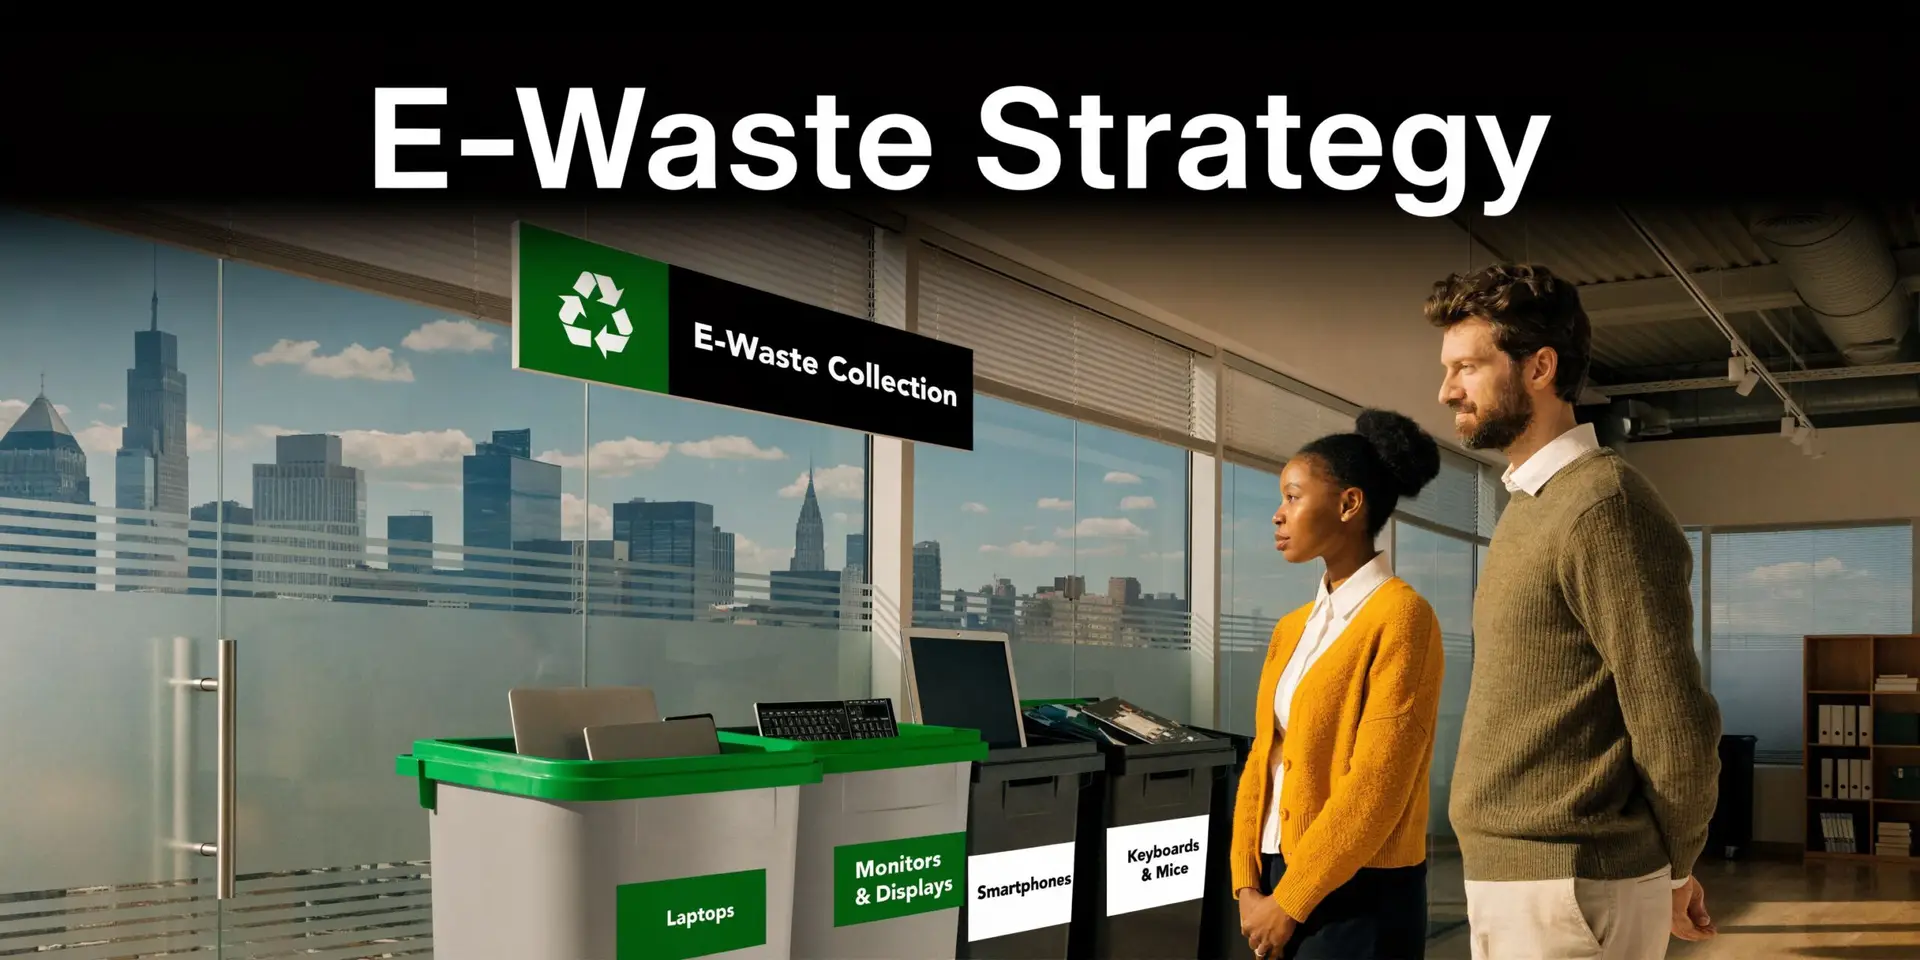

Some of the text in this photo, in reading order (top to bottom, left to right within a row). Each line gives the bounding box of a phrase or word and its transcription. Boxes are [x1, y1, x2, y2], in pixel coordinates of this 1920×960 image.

[694, 321, 957, 407] E-Waste Collection
[1127, 838, 1200, 864] Keyboards
[855, 854, 942, 879] Monitors
[1141, 863, 1189, 882] & Mice
[855, 877, 953, 906] & Displays
[977, 874, 1072, 900] Smartphones
[667, 903, 735, 929] Laptops
